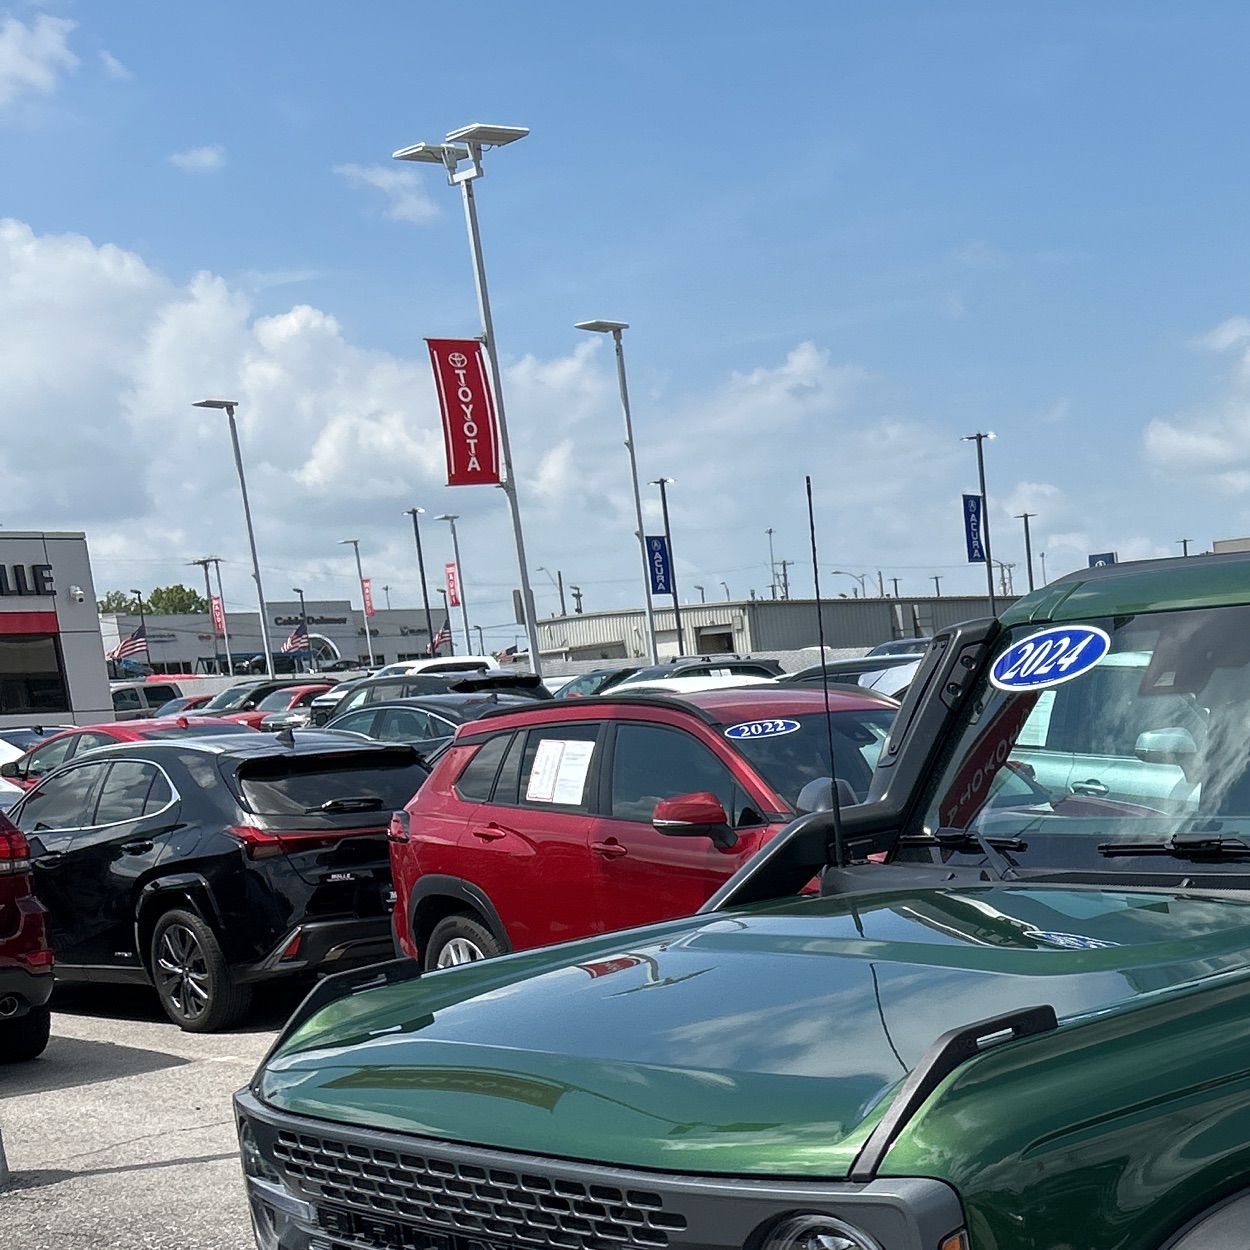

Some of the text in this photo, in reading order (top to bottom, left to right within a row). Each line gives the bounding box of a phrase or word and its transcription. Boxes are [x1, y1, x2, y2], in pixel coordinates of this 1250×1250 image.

[455, 369, 481, 471] TOYOTA
[970, 513, 981, 558] ACURA
[654, 552, 666, 590] ACURA
[999, 634, 1095, 680] 2024
[739, 720, 786, 737] 2022
